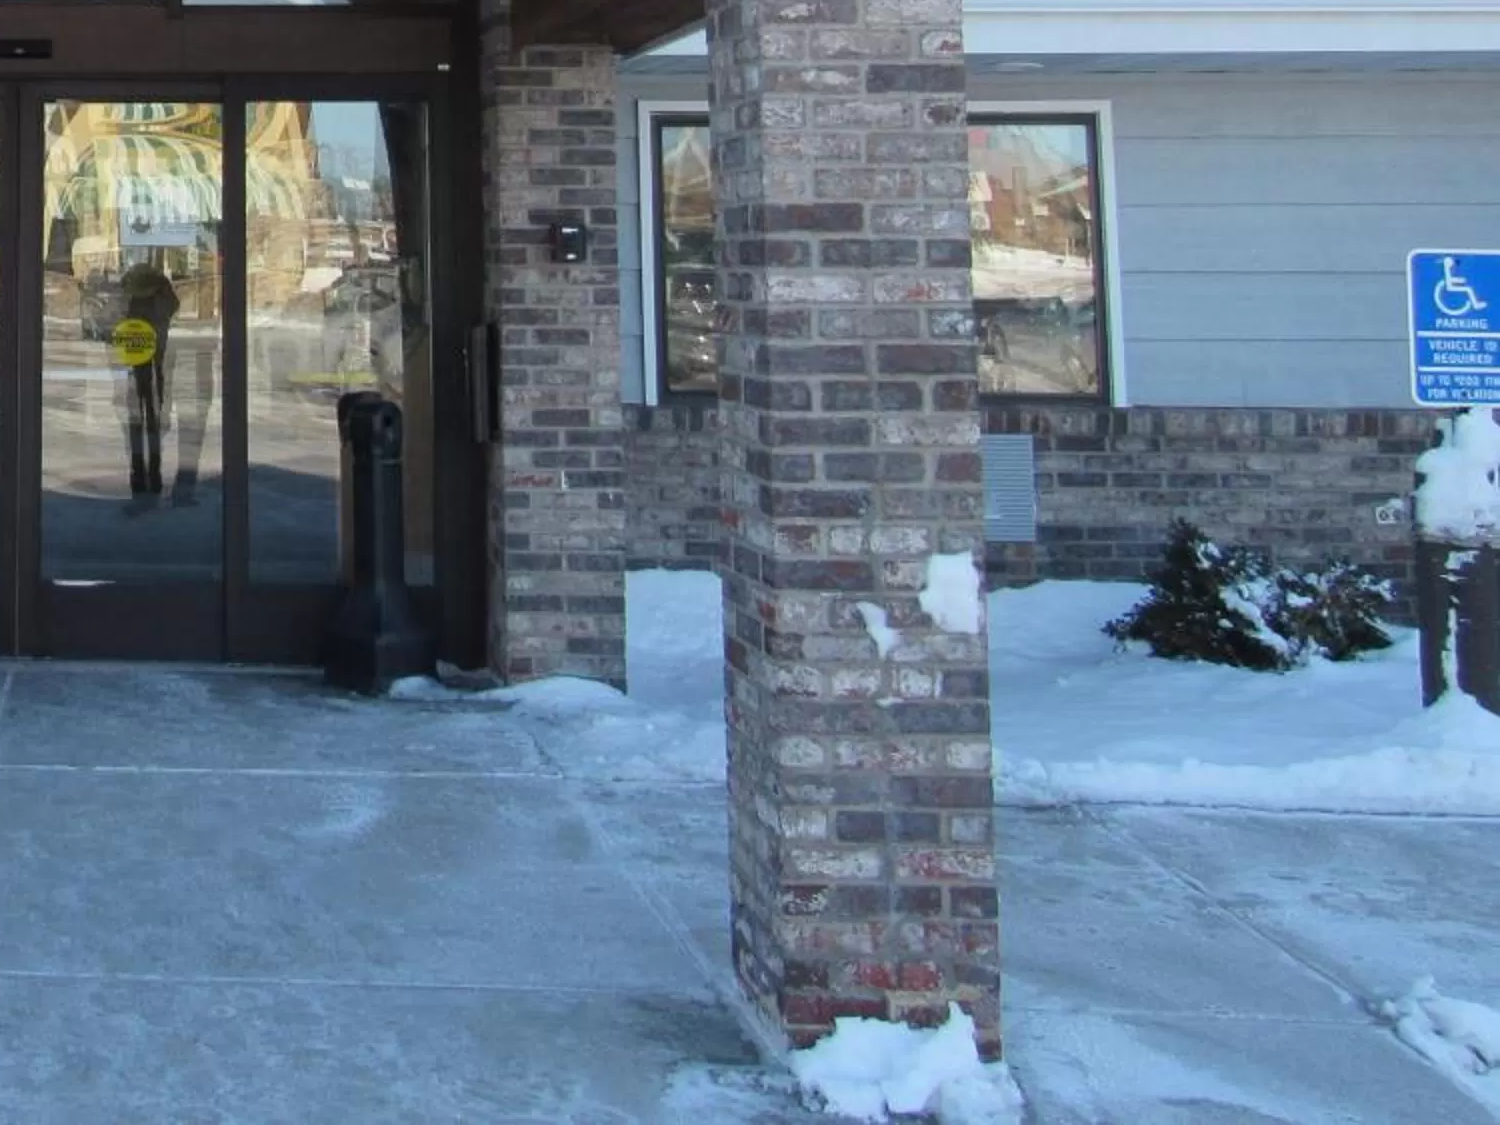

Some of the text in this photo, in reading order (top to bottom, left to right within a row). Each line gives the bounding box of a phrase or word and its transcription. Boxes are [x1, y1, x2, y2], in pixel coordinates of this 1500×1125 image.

[1434, 318, 1489, 330] PARKING
[1427, 339, 1478, 351] VEHICLE
[1433, 353, 1493, 365] REQUIRED
